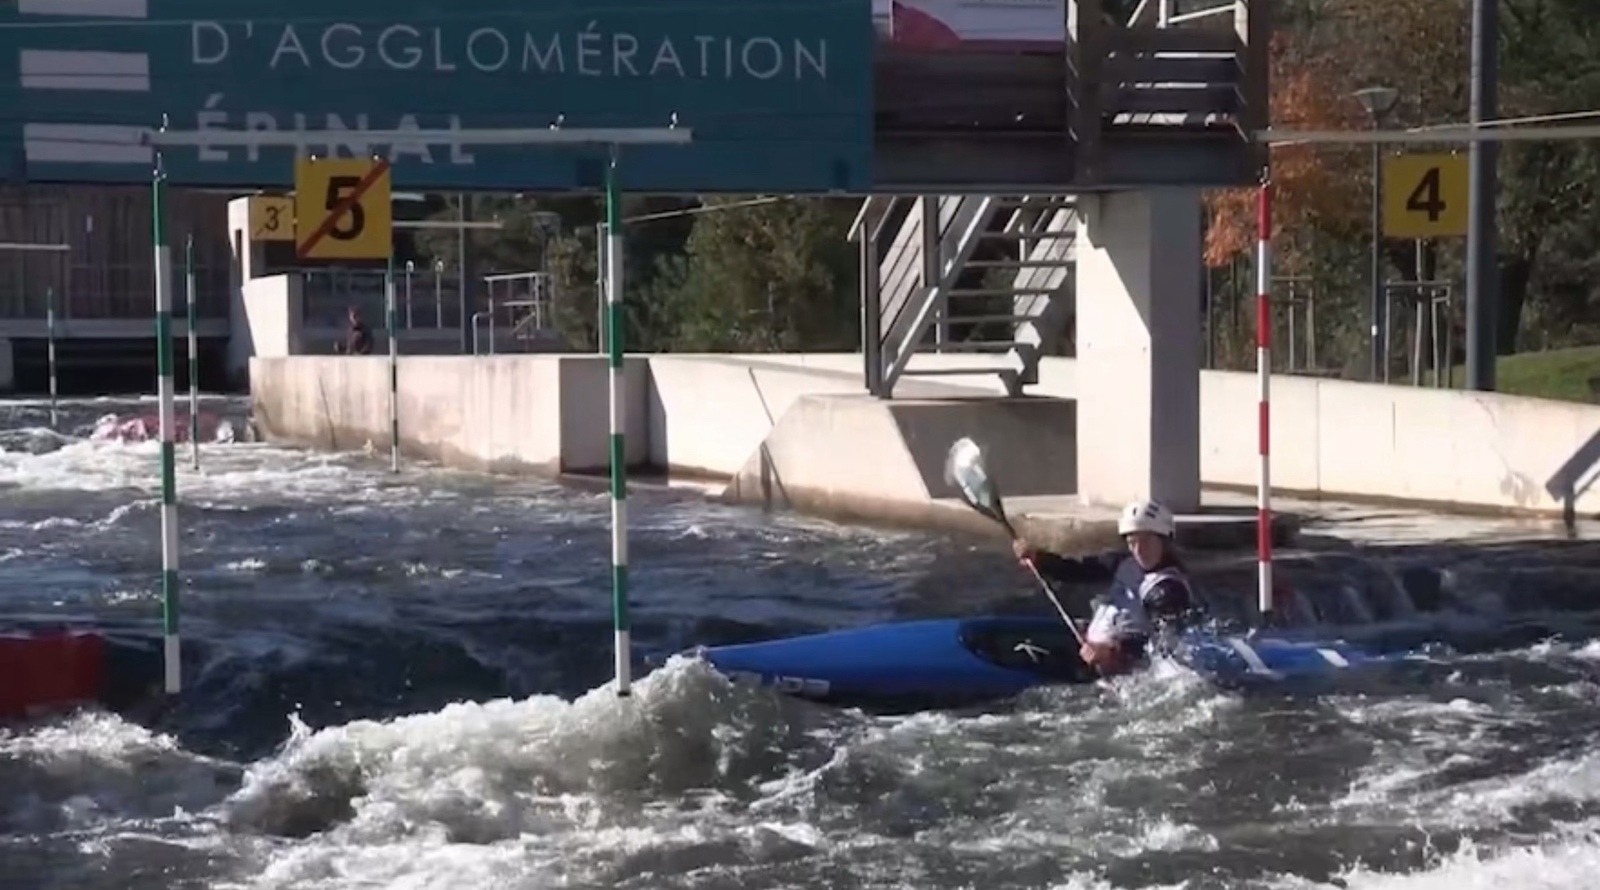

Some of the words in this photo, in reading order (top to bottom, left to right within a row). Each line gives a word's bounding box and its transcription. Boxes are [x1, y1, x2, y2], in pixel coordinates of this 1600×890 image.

[192, 21, 827, 79] D'AGGLOMÉRATION
[264, 206, 281, 232] 3
[325, 176, 365, 240] 5
[1406, 167, 1446, 222] 4
